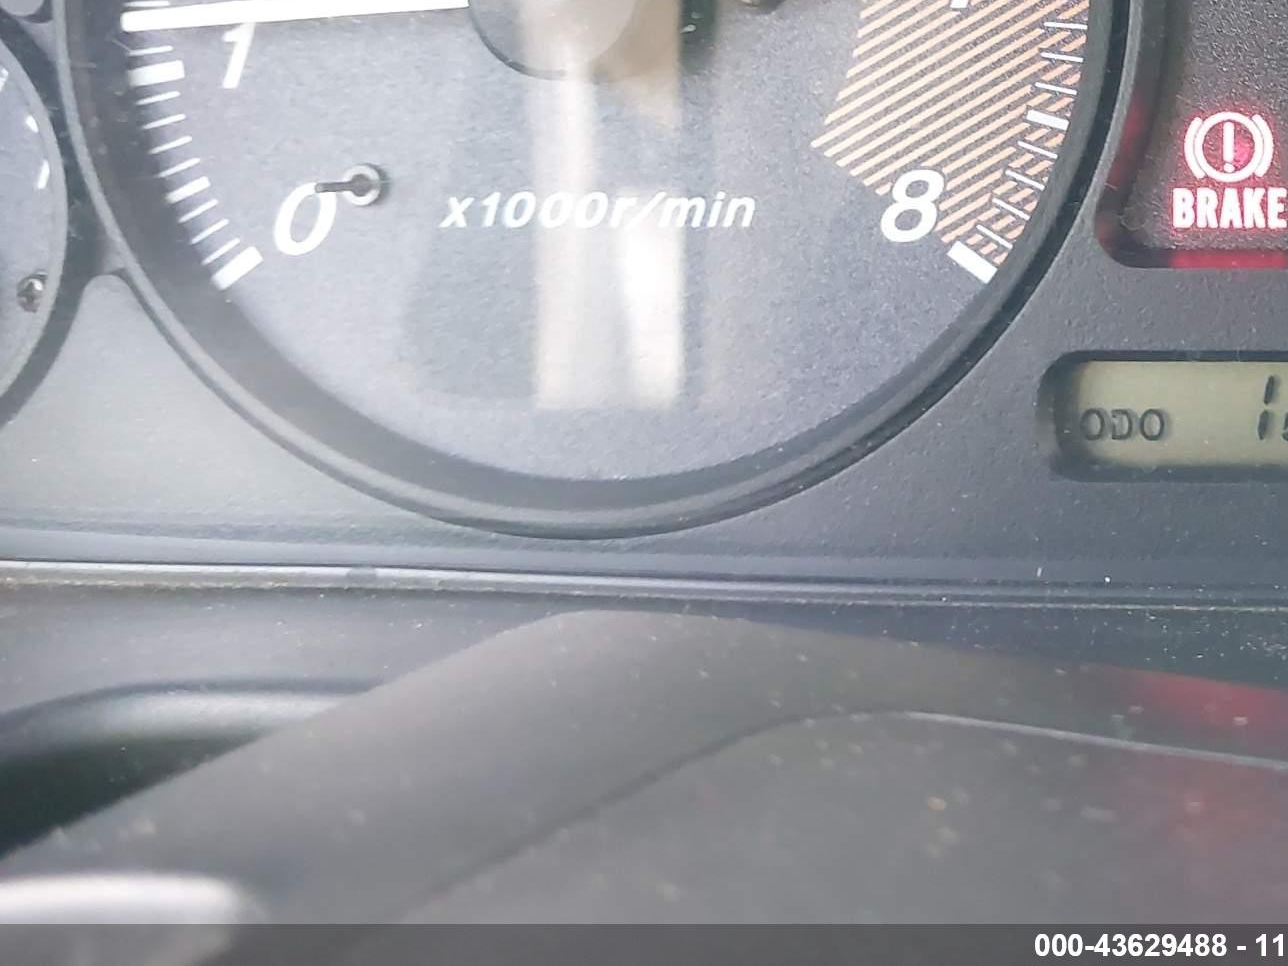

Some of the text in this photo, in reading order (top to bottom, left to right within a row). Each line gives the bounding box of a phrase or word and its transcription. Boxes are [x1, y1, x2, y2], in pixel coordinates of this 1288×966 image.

[222, 20, 256, 89] 1
[273, 182, 337, 256] 0
[439, 191, 756, 228] x1000r/min
[880, 169, 947, 243] 8
[1172, 187, 1288, 229] BRAKE
[1079, 407, 1166, 442] ODO
